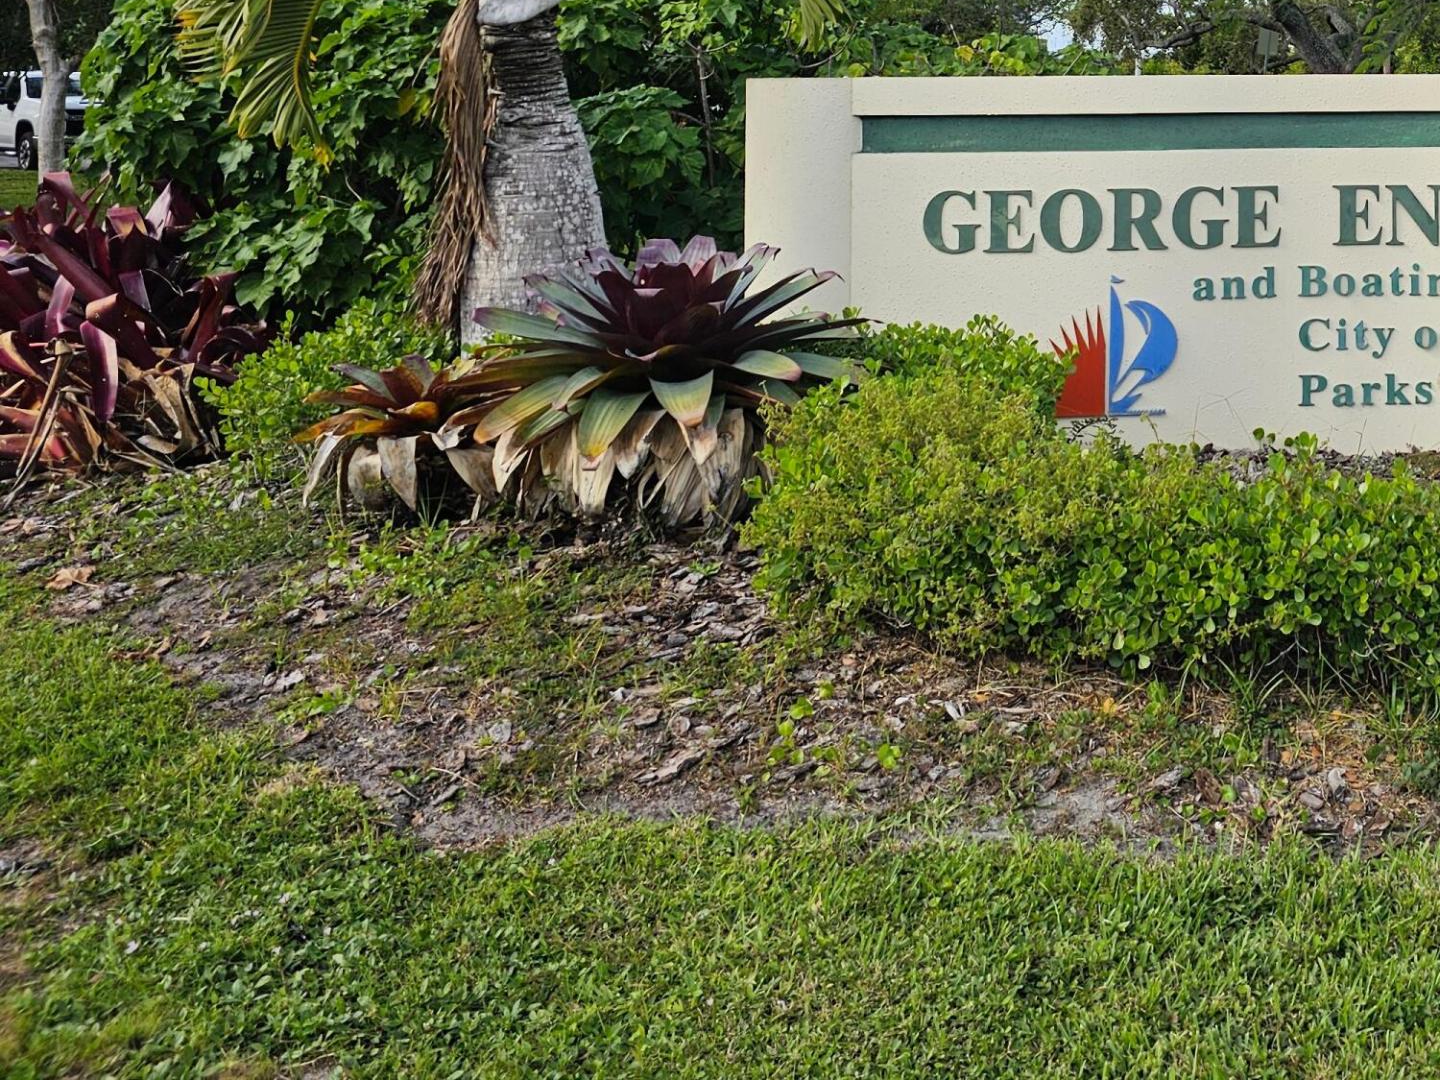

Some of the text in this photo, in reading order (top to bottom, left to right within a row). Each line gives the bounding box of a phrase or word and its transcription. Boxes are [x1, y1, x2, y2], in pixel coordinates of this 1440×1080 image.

[923, 185, 1282, 255] GEORGE
[1193, 267, 1277, 302] and
[1299, 317, 1396, 360] City
[1299, 374, 1432, 409] Parks
